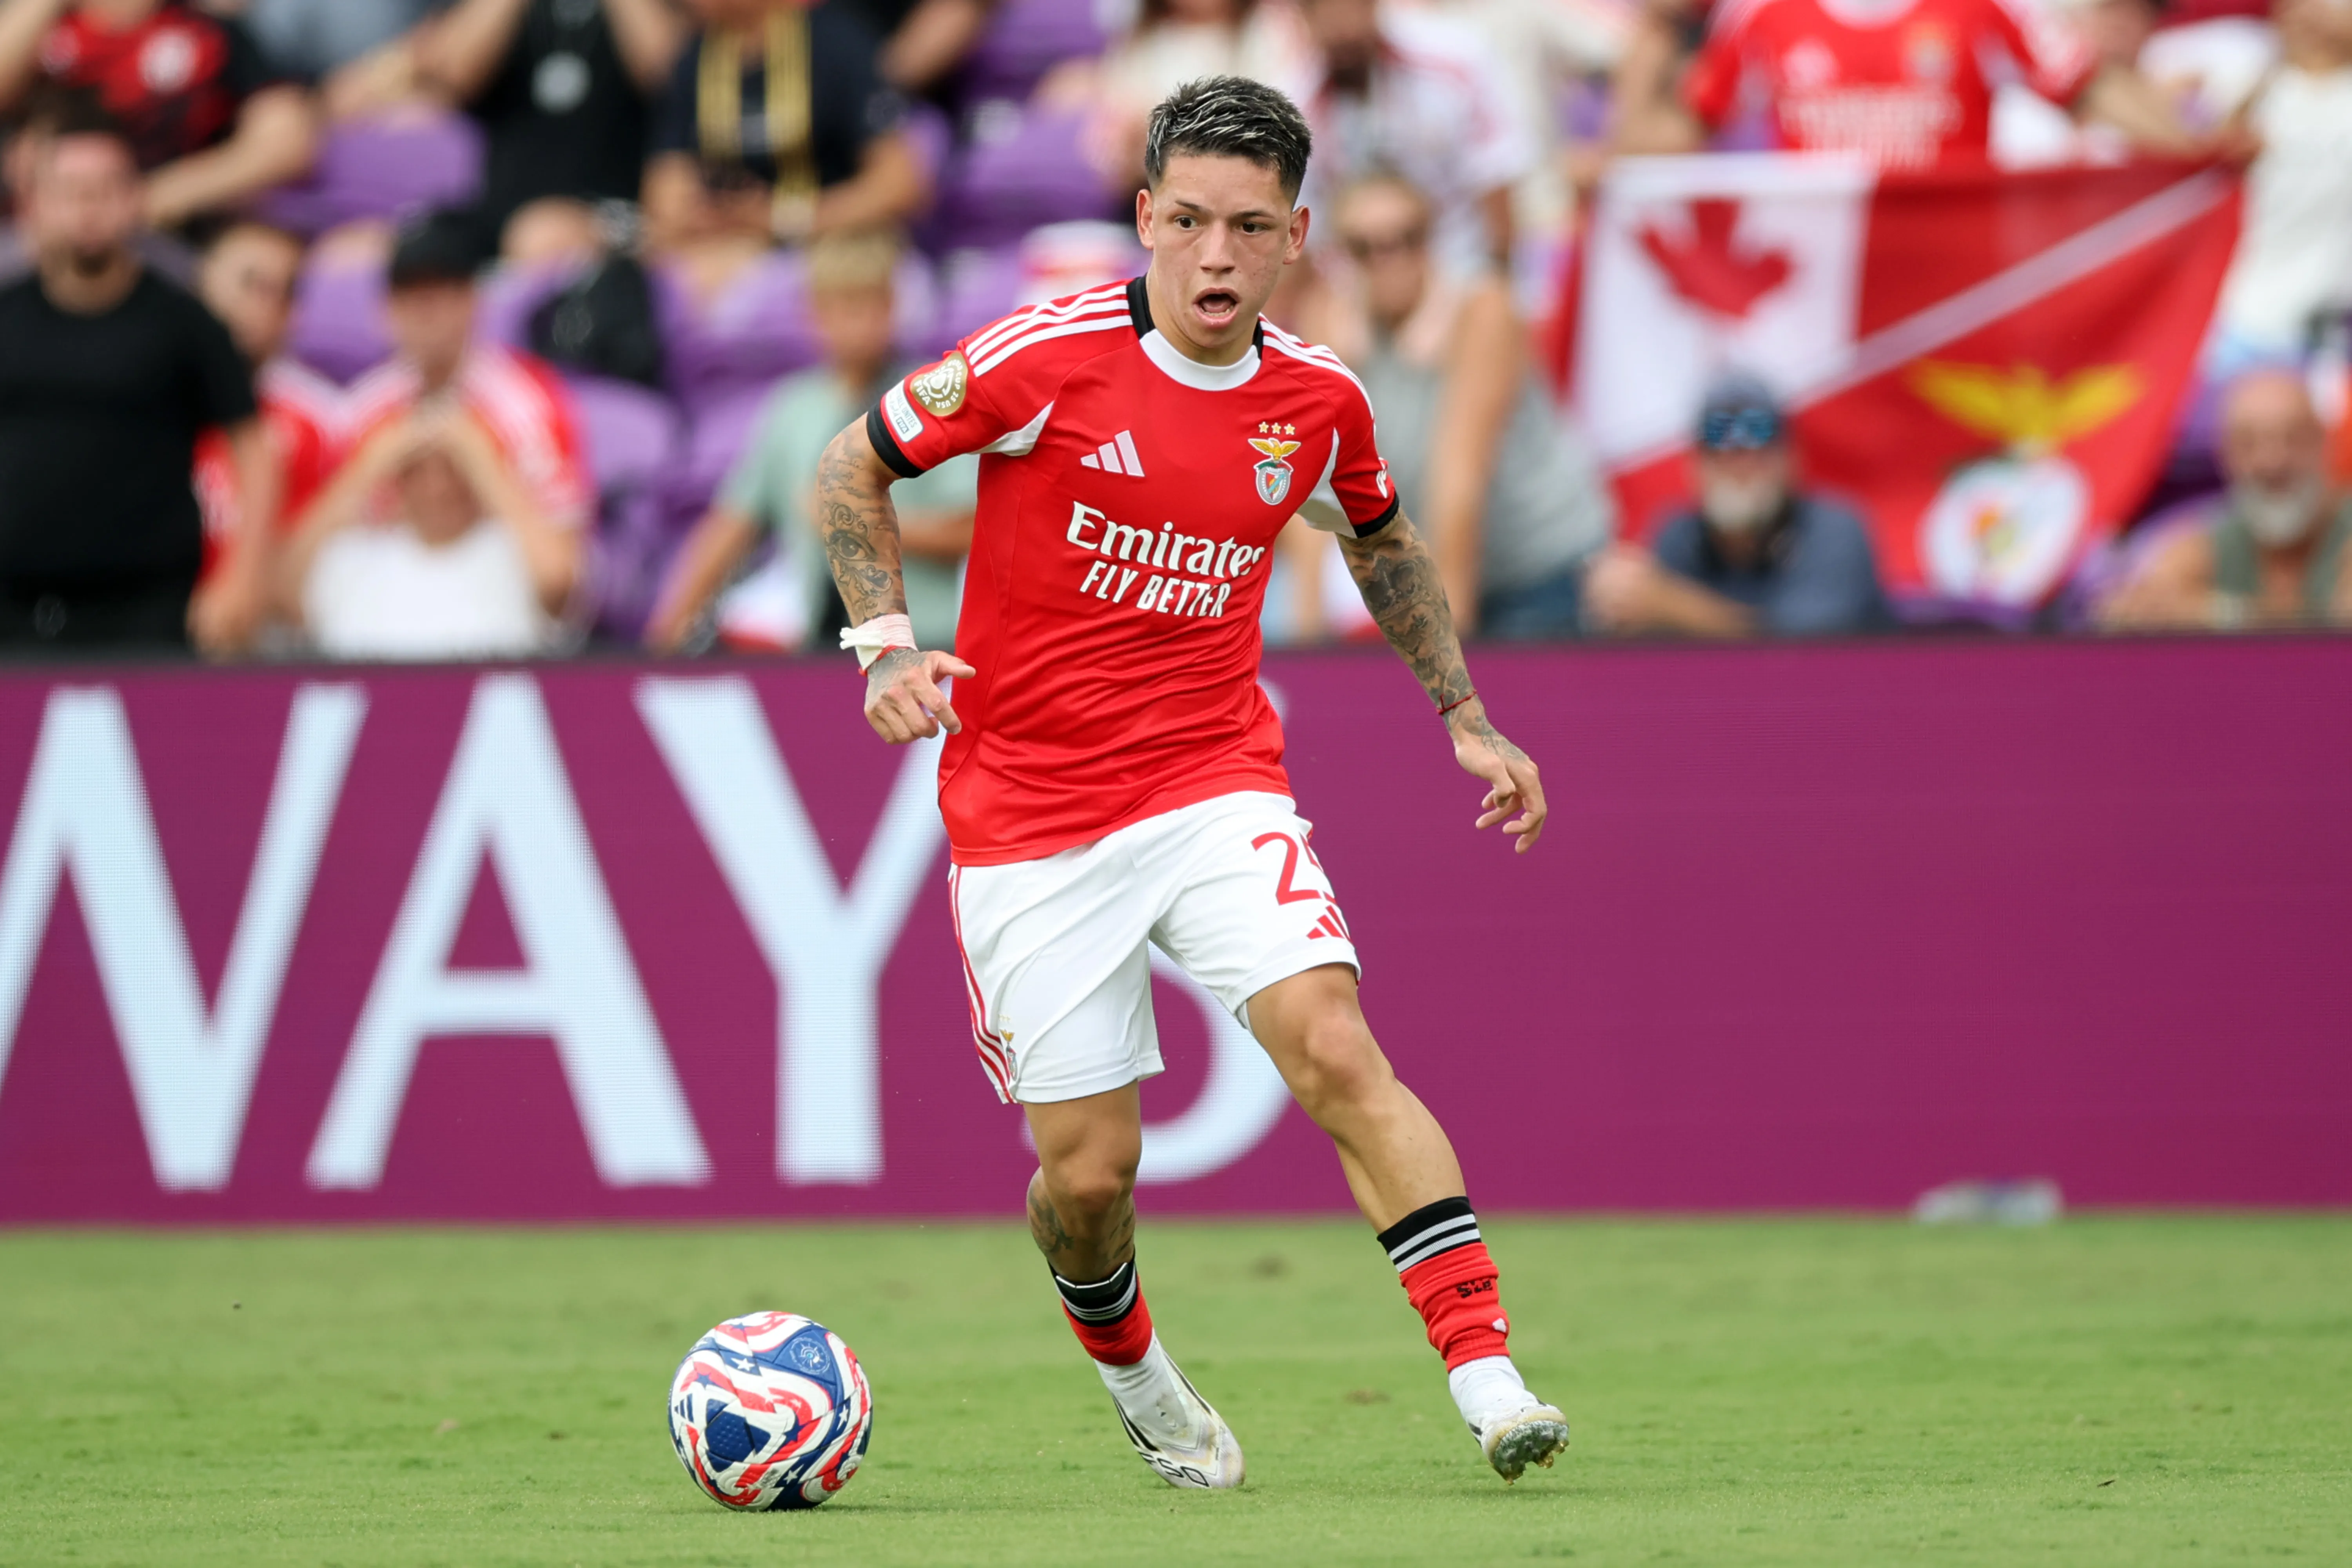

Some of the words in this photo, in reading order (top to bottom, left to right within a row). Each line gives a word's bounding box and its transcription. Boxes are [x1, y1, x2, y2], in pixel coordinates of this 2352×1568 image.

[914, 379, 931, 405] FIFA
[950, 391, 959, 402] 25
[936, 400, 951, 408] USA
[1080, 560, 1139, 603] FLY
[1136, 574, 1231, 618] BETTER
